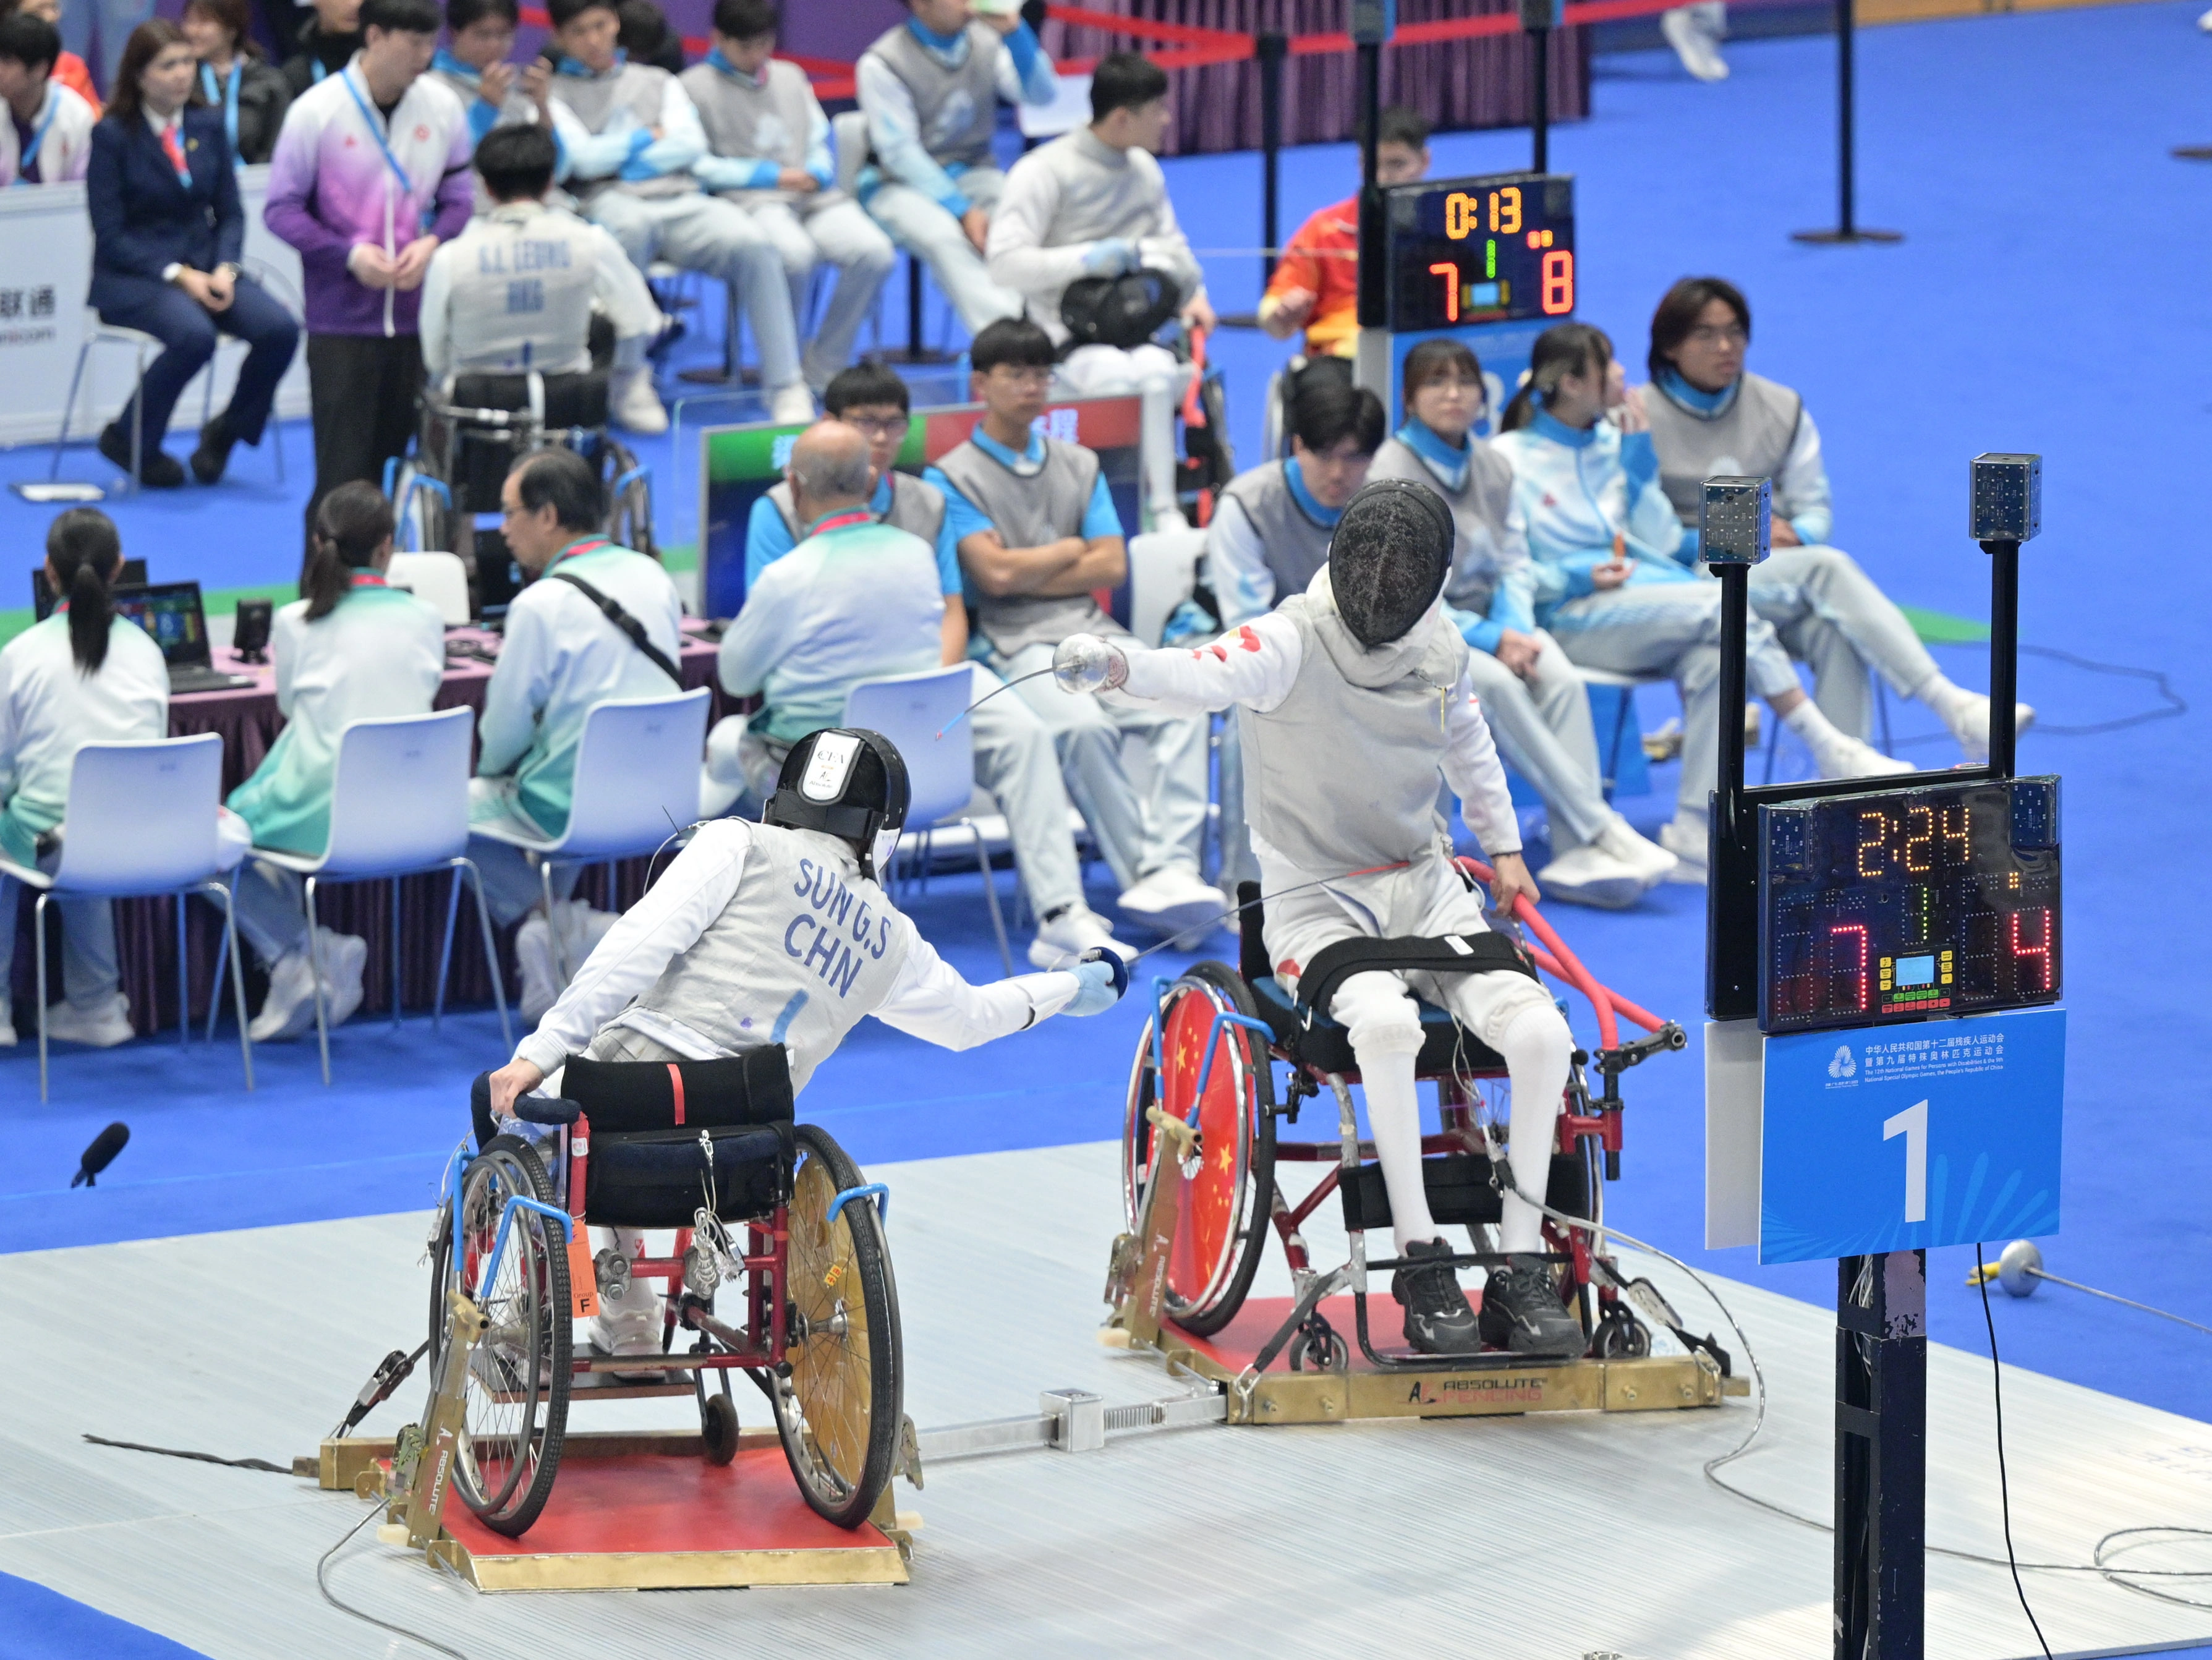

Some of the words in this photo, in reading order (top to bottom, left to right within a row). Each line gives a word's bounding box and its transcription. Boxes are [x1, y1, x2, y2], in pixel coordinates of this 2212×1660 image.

[1445, 187, 1521, 240] 0:13
[1429, 262, 1458, 322] 7
[1542, 249, 1573, 315] 8
[1858, 806, 1970, 877] 2:24
[785, 913, 864, 999] CHN
[1832, 924, 1866, 1010] 7
[2013, 909, 2050, 989] 4
[1865, 1032, 2004, 1055] 中华人民共和国第十二届残疾人运动会
[1865, 1044, 2004, 1067] 暨第九届特殊奥林匹克运动会
[1883, 1099, 1928, 1223] 1
[580, 1298, 590, 1314] F
[1150, 1255, 1166, 1317] ABSOLUTE
[1444, 1377, 1546, 1390] ABSOLUTE
[429, 1450, 448, 1515] ABSOLUTE
